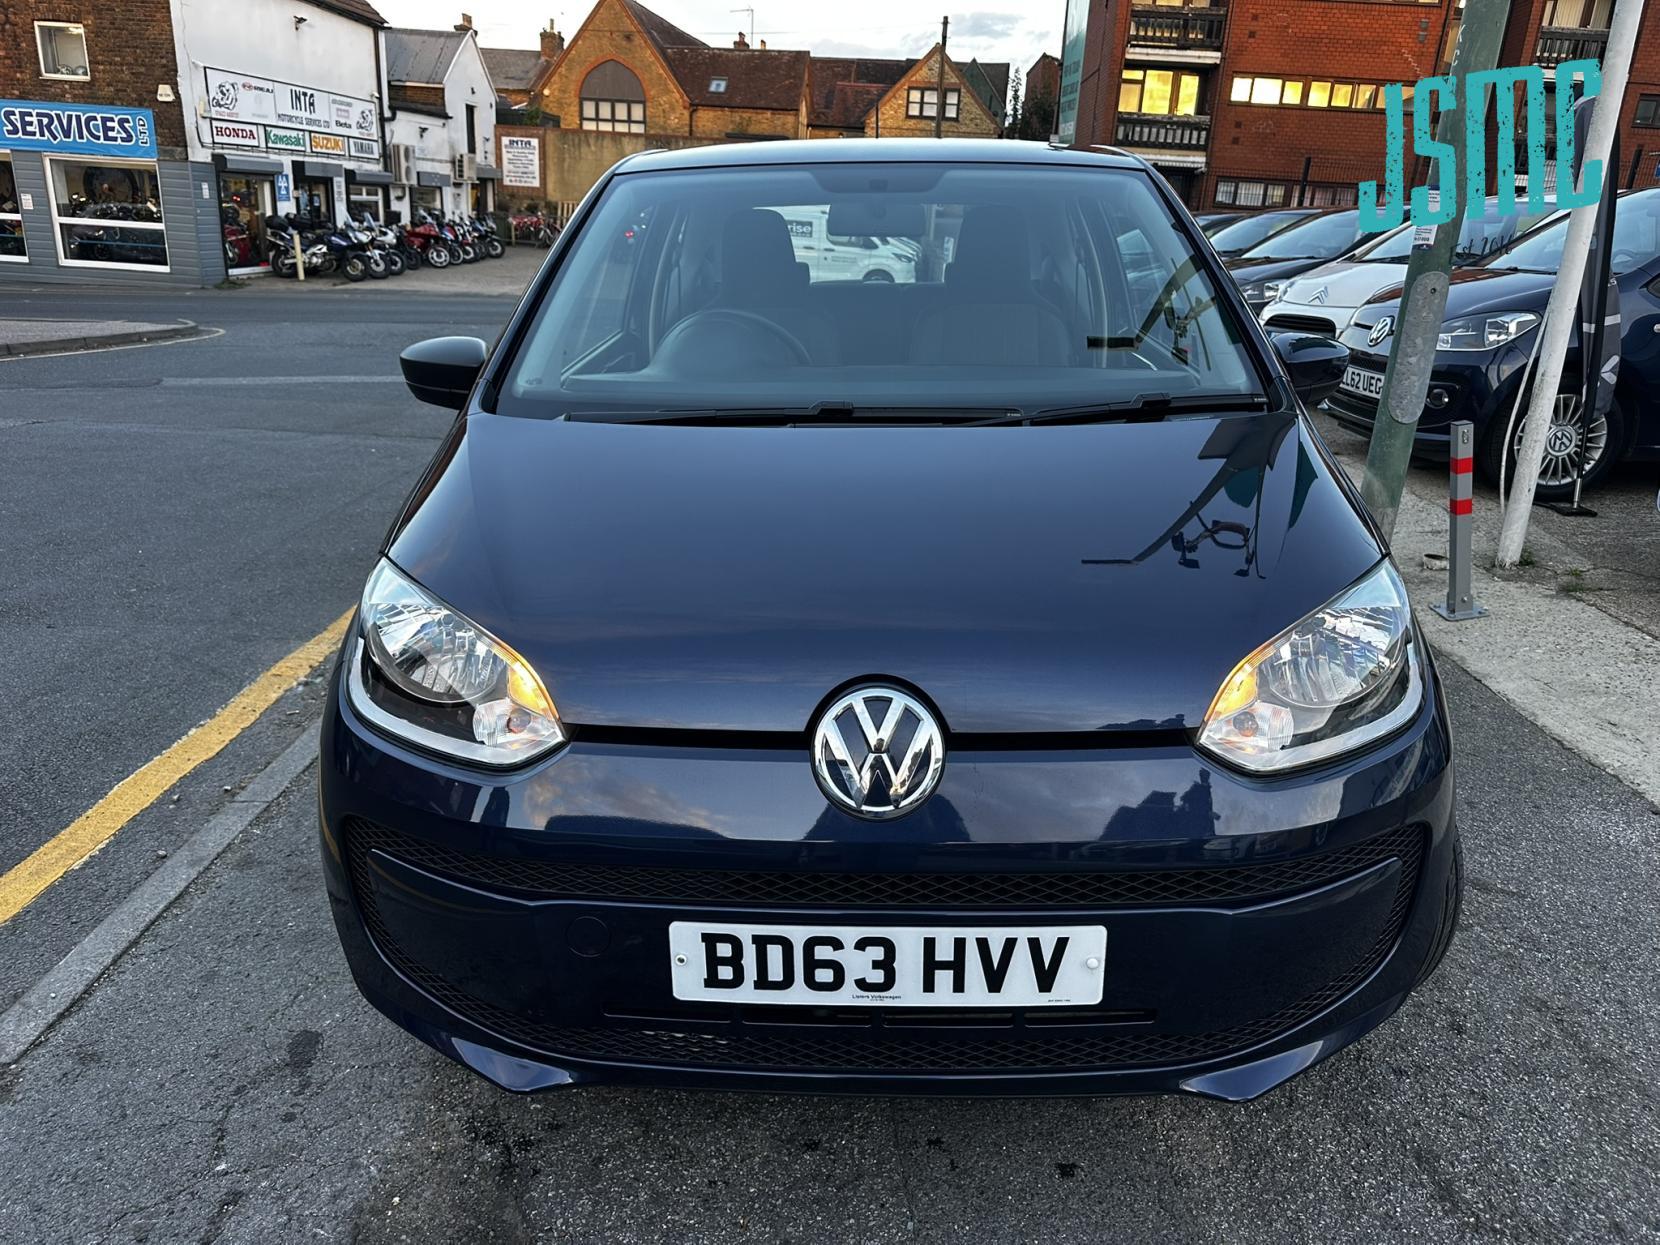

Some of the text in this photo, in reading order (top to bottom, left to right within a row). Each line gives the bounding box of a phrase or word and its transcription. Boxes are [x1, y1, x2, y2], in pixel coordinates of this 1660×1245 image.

[290, 88, 316, 115] INTA
[1, 108, 150, 146] SERVICES LTD
[214, 126, 256, 140] HONDA
[266, 129, 305, 147] Kawasaki
[312, 135, 345, 152] SUZUKI
[353, 141, 374, 155] YAMAHA
[787, 222, 812, 233] rise
[1342, 369, 1361, 389] L62
[700, 932, 1070, 993] BD63 HVV
